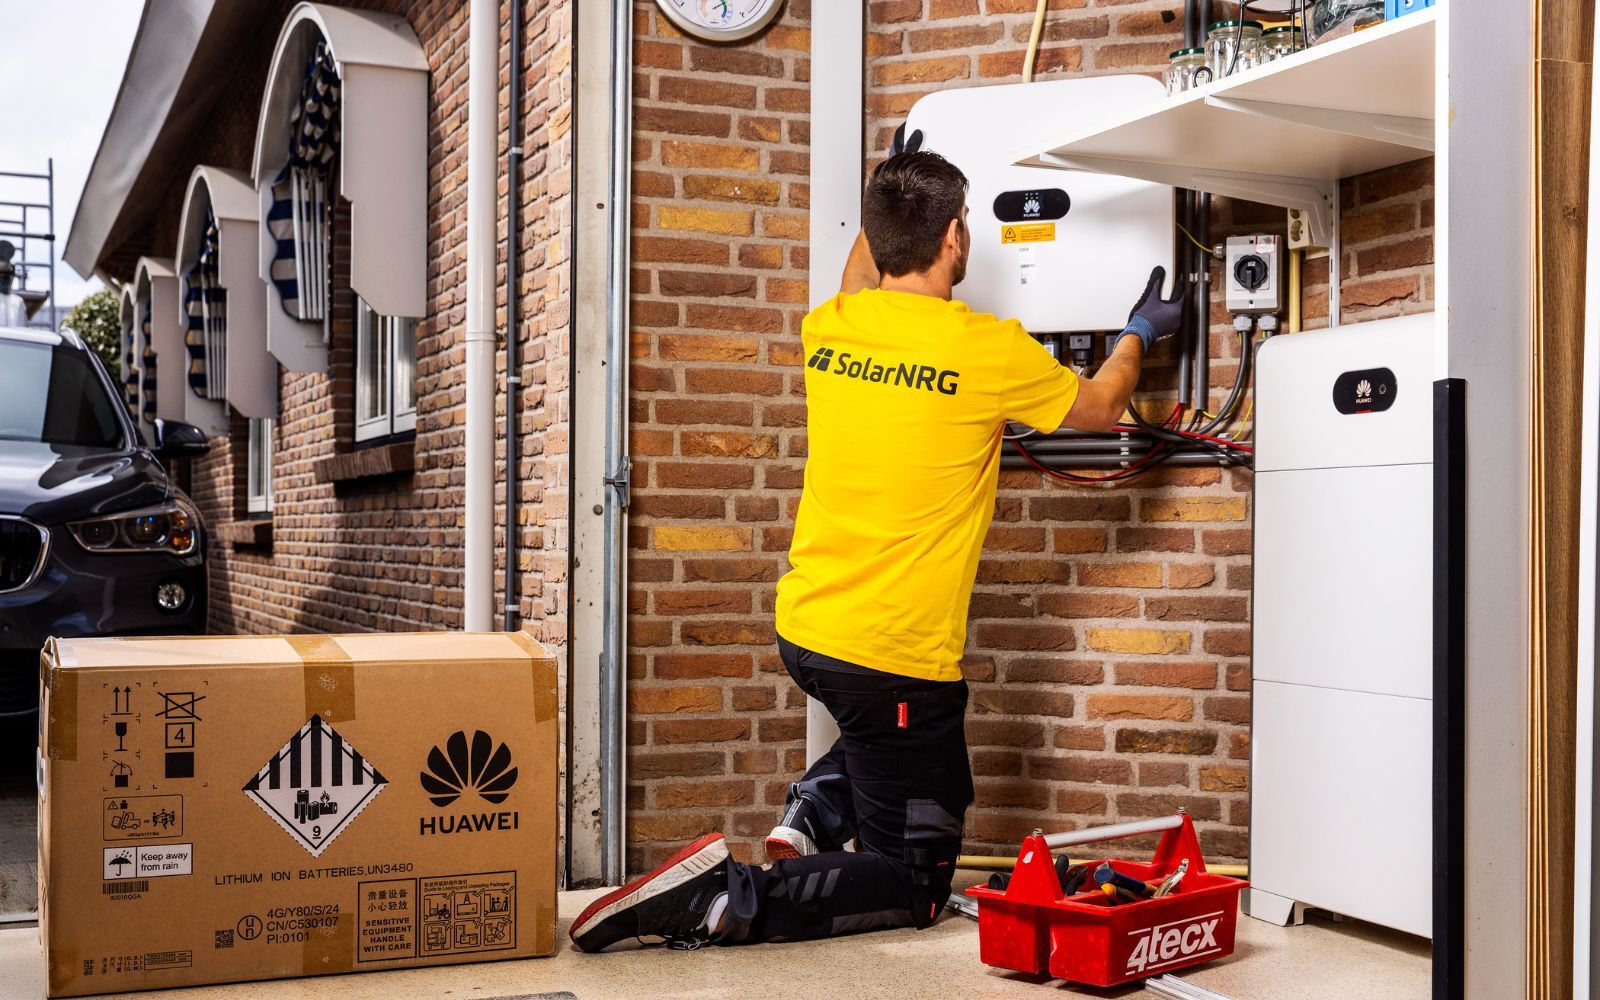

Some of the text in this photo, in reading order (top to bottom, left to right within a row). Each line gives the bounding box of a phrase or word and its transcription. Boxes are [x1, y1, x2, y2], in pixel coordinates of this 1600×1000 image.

[834, 352, 960, 396] SolarNRG
[174, 727, 186, 743] 4
[420, 811, 519, 835] HUAWEI
[312, 825, 321, 838] 9
[141, 851, 188, 862] Keep away
[141, 861, 179, 871] from rain
[215, 873, 263, 885] LITHIUM
[271, 871, 291, 882] ION
[368, 889, 408, 900] 贵重设备
[267, 904, 340, 918] 4G/Y80/S/24
[368, 901, 408, 912] 小心轻放
[267, 916, 339, 931] CN/C530107
[366, 917, 410, 926] SENSITIVE
[362, 926, 412, 935] EQUIPMENT
[267, 931, 310, 944] PI:0101
[370, 935, 405, 943] HANDLE
[364, 942, 411, 952] WITH CARE
[1126, 918, 1219, 972] 4tecx
